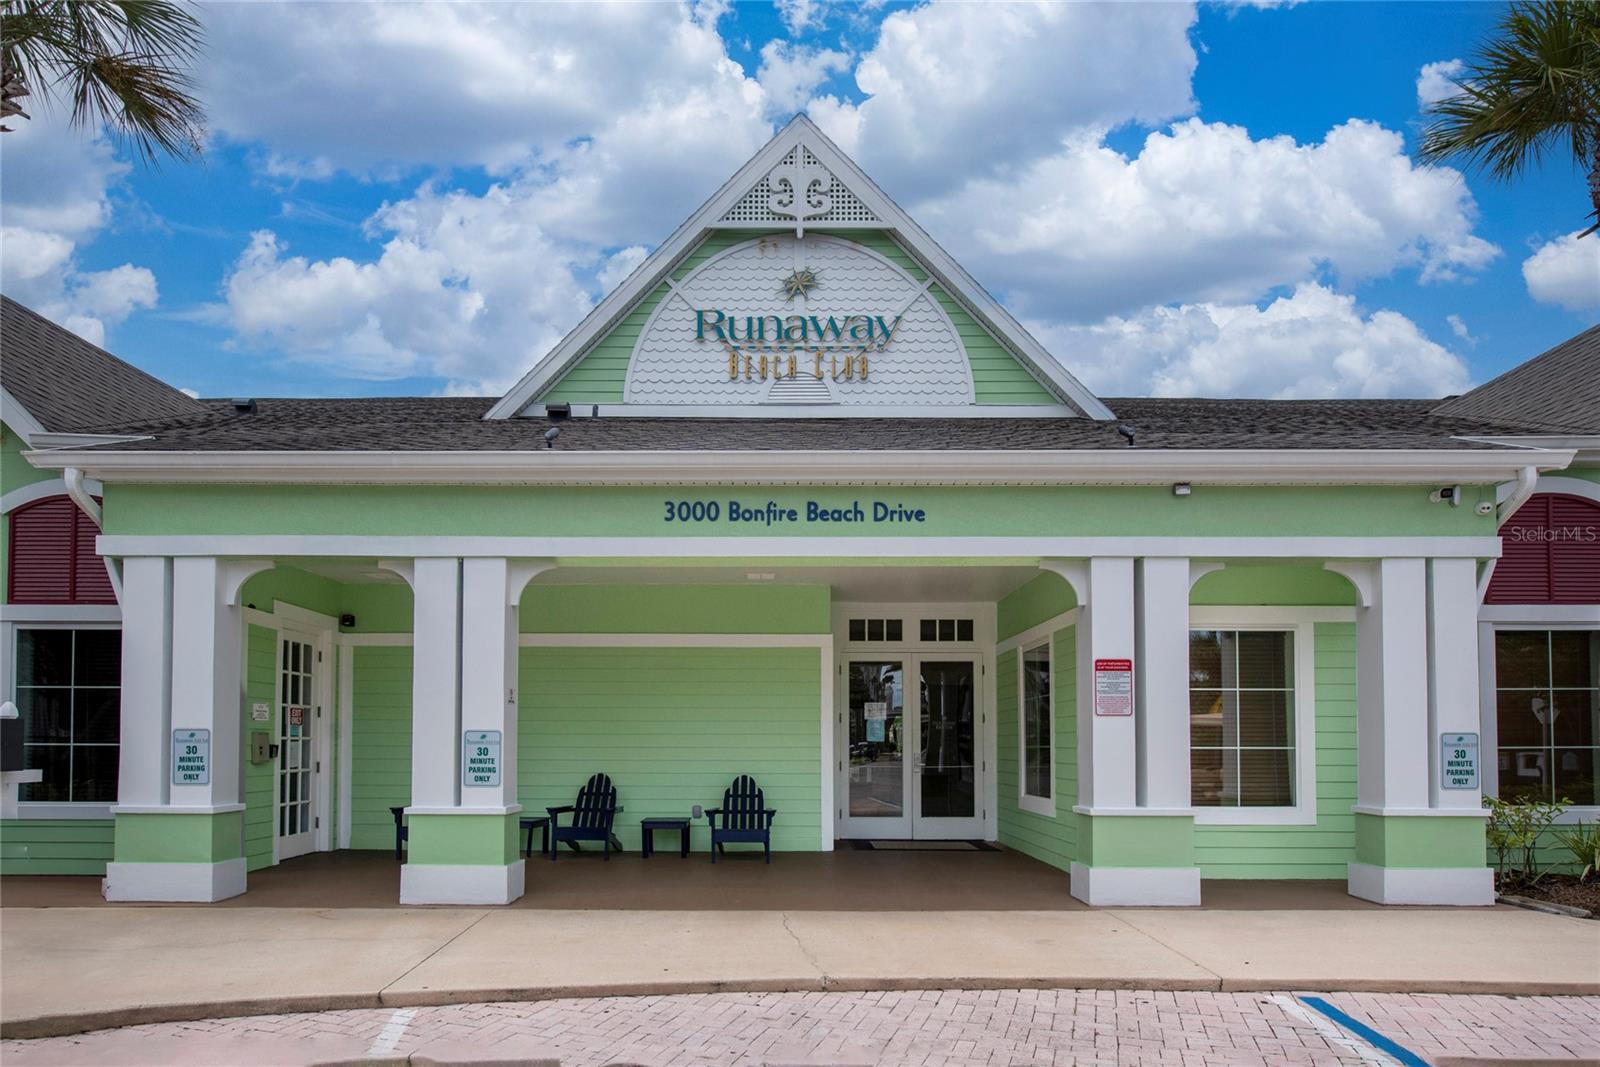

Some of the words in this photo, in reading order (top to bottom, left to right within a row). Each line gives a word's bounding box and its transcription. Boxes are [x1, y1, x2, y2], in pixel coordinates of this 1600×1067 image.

[696, 309, 902, 351] Runaway
[664, 501, 720, 522] 3000
[728, 501, 798, 526] Bonfire
[806, 501, 864, 522] Beach
[873, 501, 926, 522] Drive
[186, 745, 198, 755] 30
[476, 746, 489, 756] 30
[1454, 749, 1466, 759] 30
